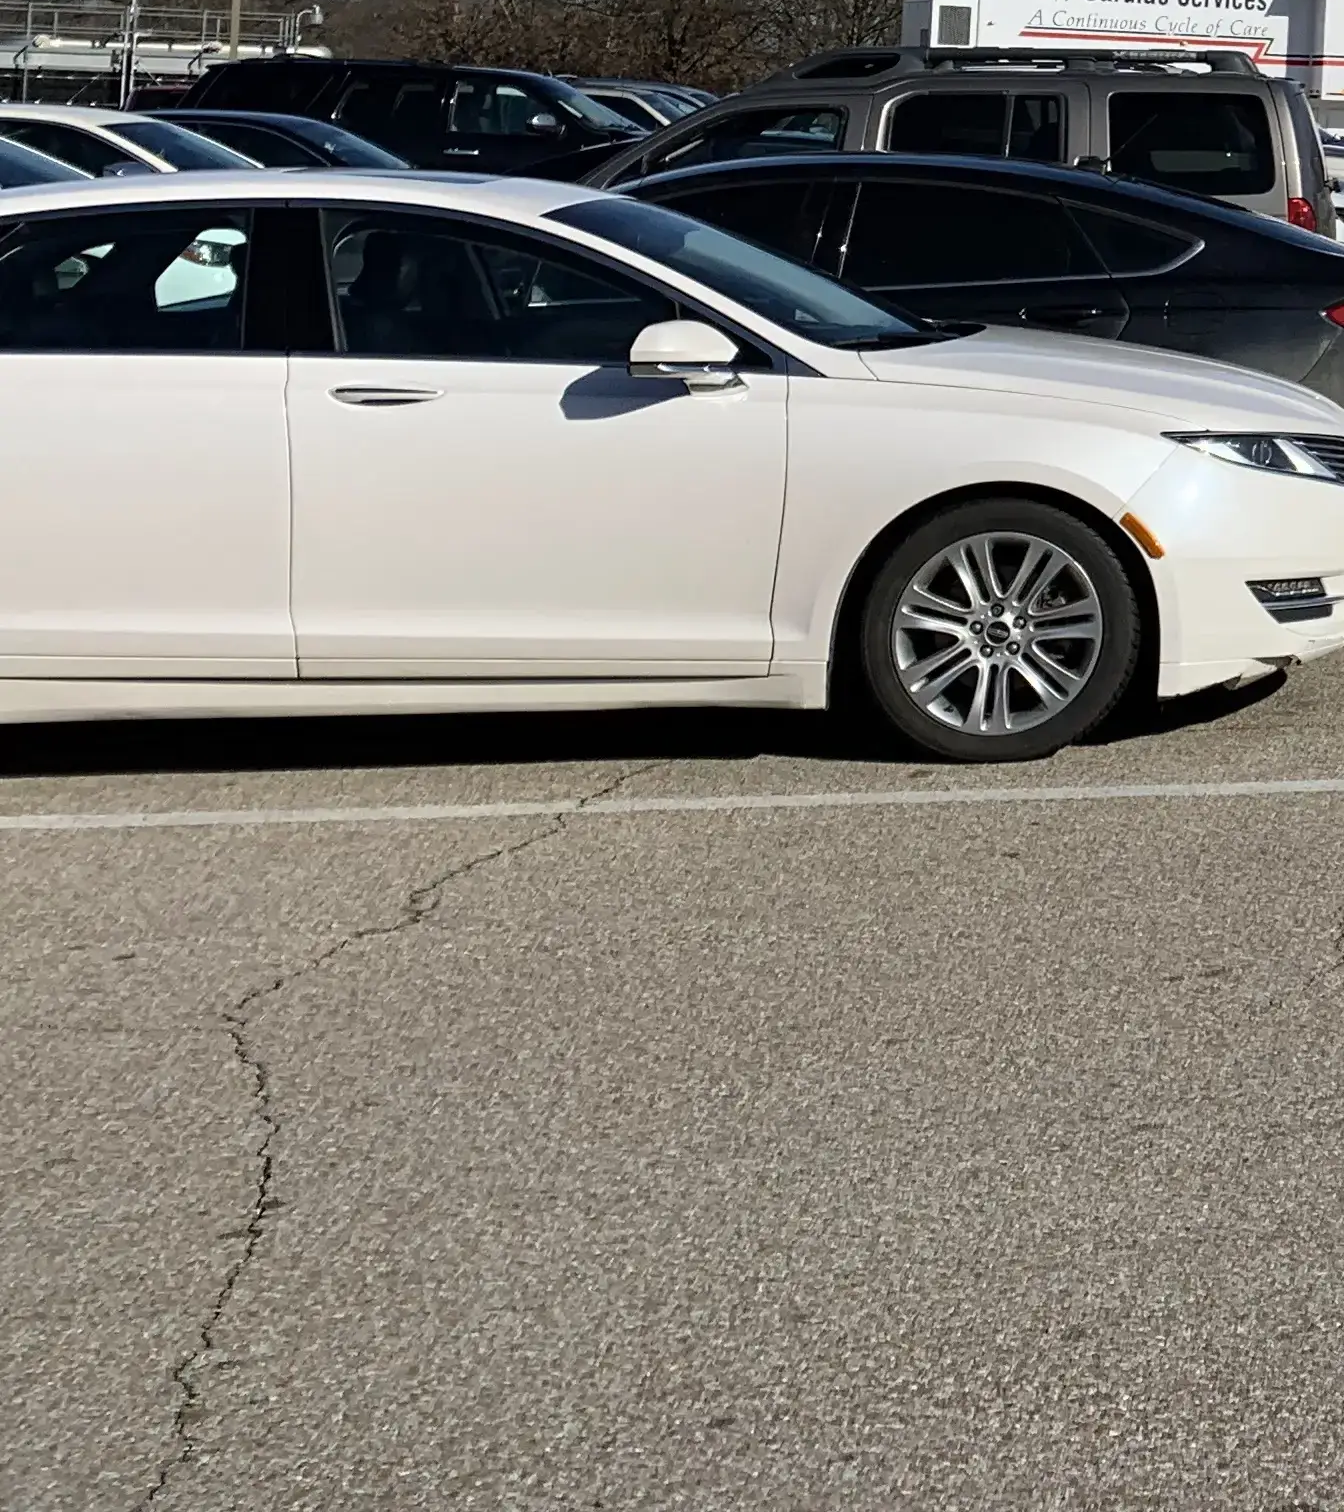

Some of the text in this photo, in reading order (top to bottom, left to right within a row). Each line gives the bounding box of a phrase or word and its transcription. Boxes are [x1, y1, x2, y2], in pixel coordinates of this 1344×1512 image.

[1027, 9, 1269, 38] A Continuous Cycle of Care
